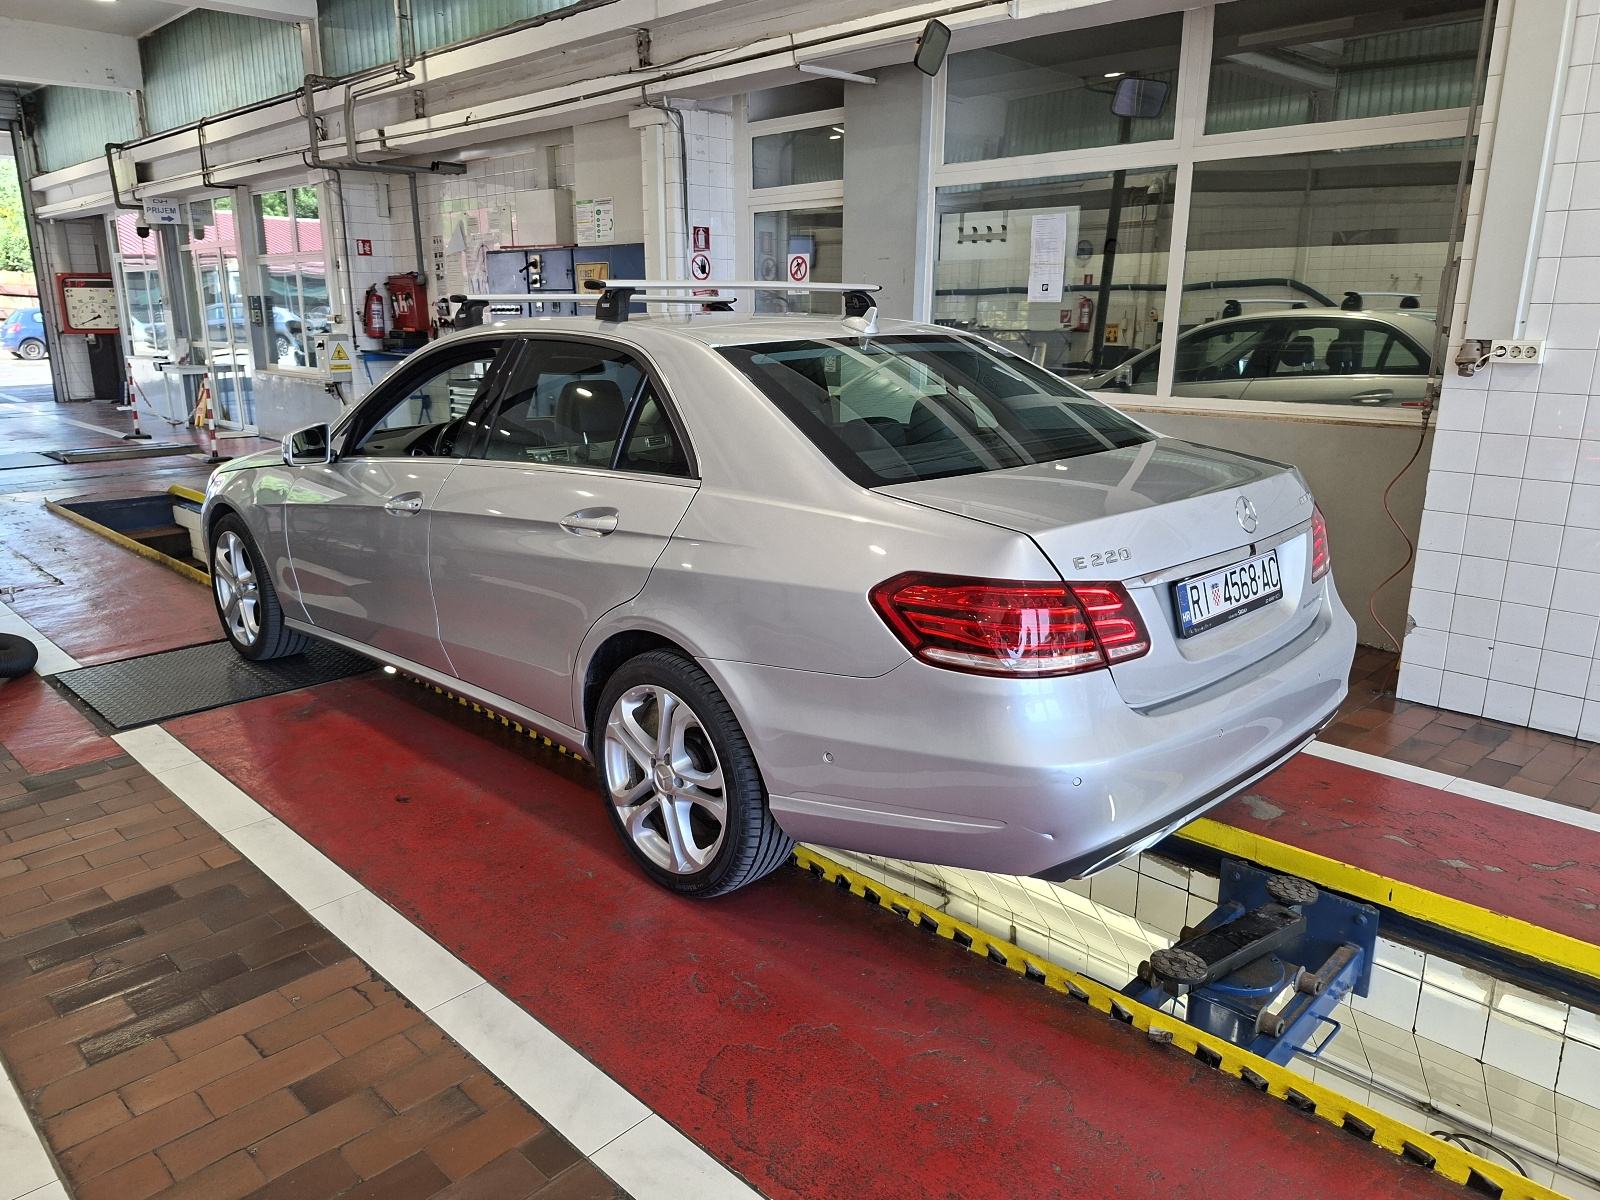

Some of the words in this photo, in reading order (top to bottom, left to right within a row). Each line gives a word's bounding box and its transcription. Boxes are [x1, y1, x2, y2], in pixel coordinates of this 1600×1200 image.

[146, 206, 177, 215] PRIJEM
[1072, 555, 1088, 571] E
[1090, 546, 1132, 568] 220
[1189, 581, 1210, 620] RI
